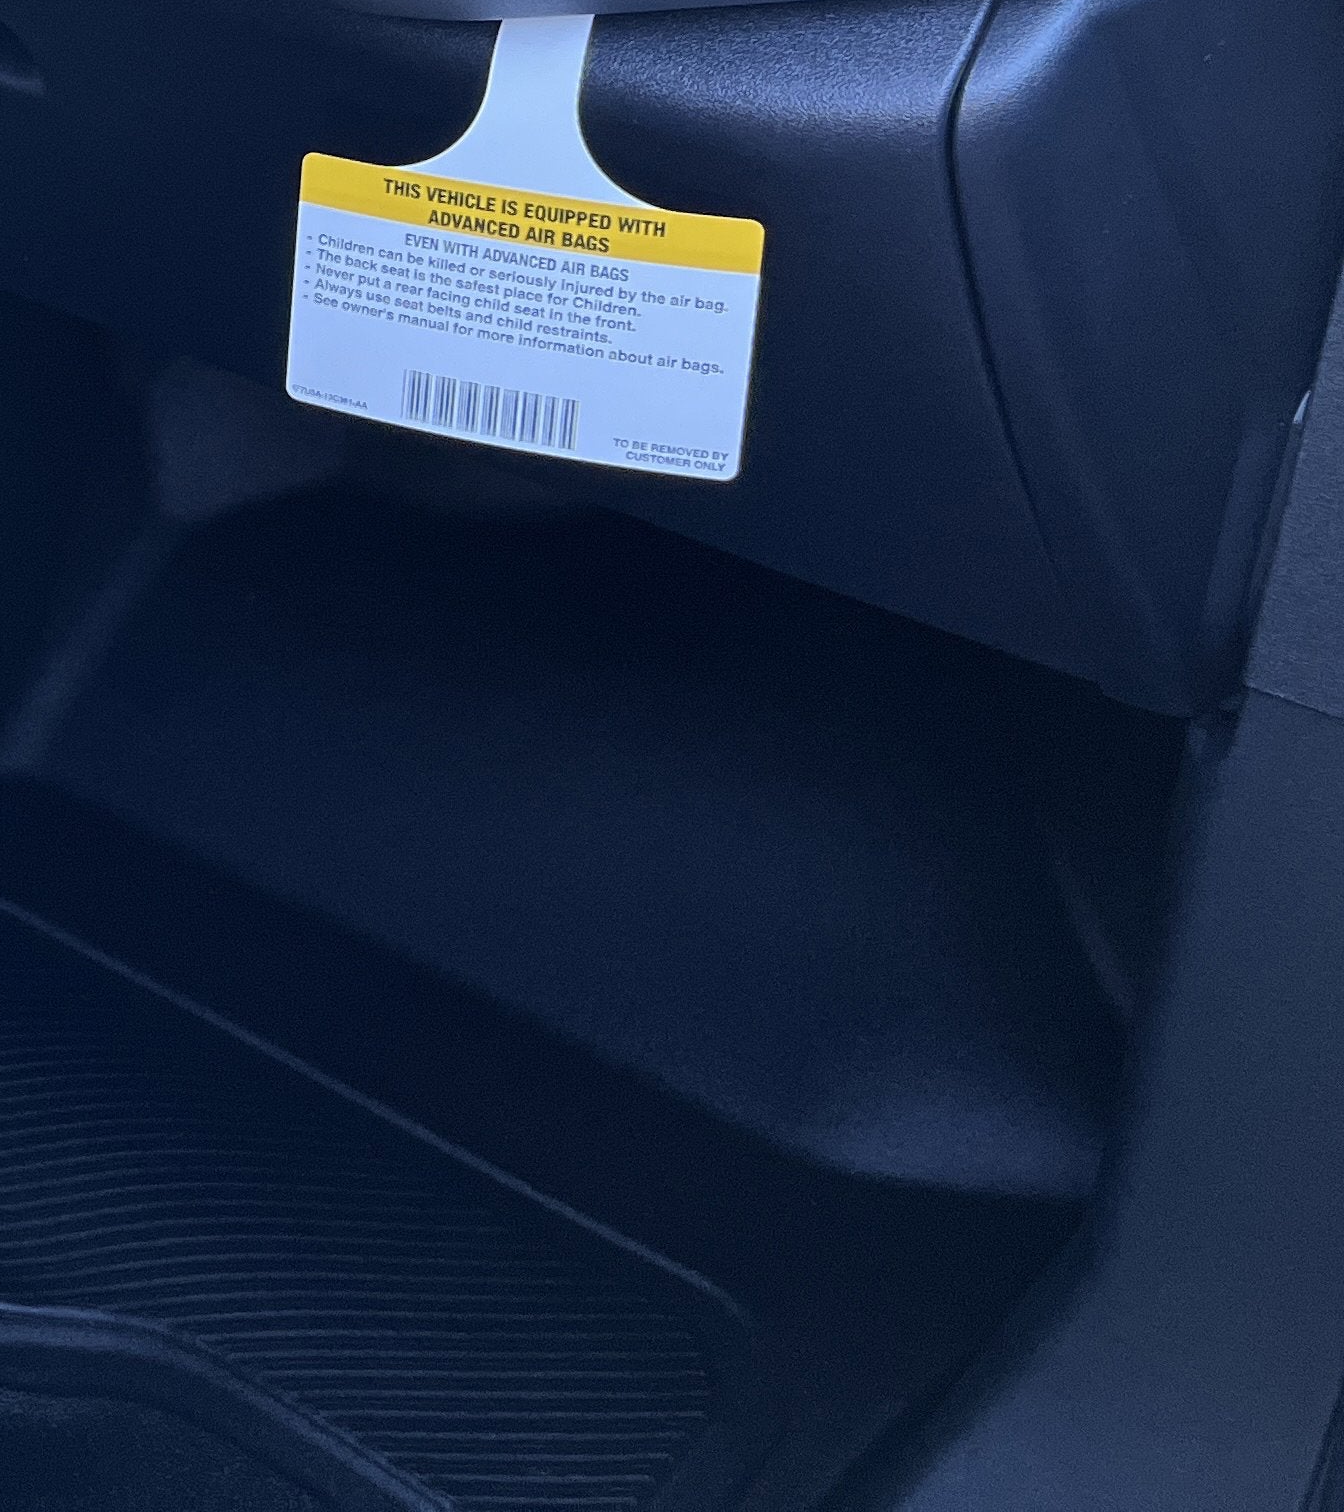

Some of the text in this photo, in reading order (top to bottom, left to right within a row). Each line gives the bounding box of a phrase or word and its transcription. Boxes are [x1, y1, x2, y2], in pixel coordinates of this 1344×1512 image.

[384, 178, 667, 238] THIS VEHICLE IS EQUIPPED WITH
[428, 210, 610, 253] ADVANCED AIR BAGS
[317, 233, 728, 313] Children can be killed or seriously injured by the air bag.
[317, 248, 642, 317] The back seat is the safest place for Children.
[404, 233, 629, 281] EVEN WITH ADVANCED AIR BAGS
[314, 278, 612, 344] Always use seat belts and child restraints.
[315, 263, 637, 332] Never put a rear facing child seat in the front.
[313, 292, 724, 375] See owner's manual for more information about air bags.
[613, 437, 729, 461] TO BE REMOVED BY
[625, 451, 726, 472] CUSTOMER ONLY
